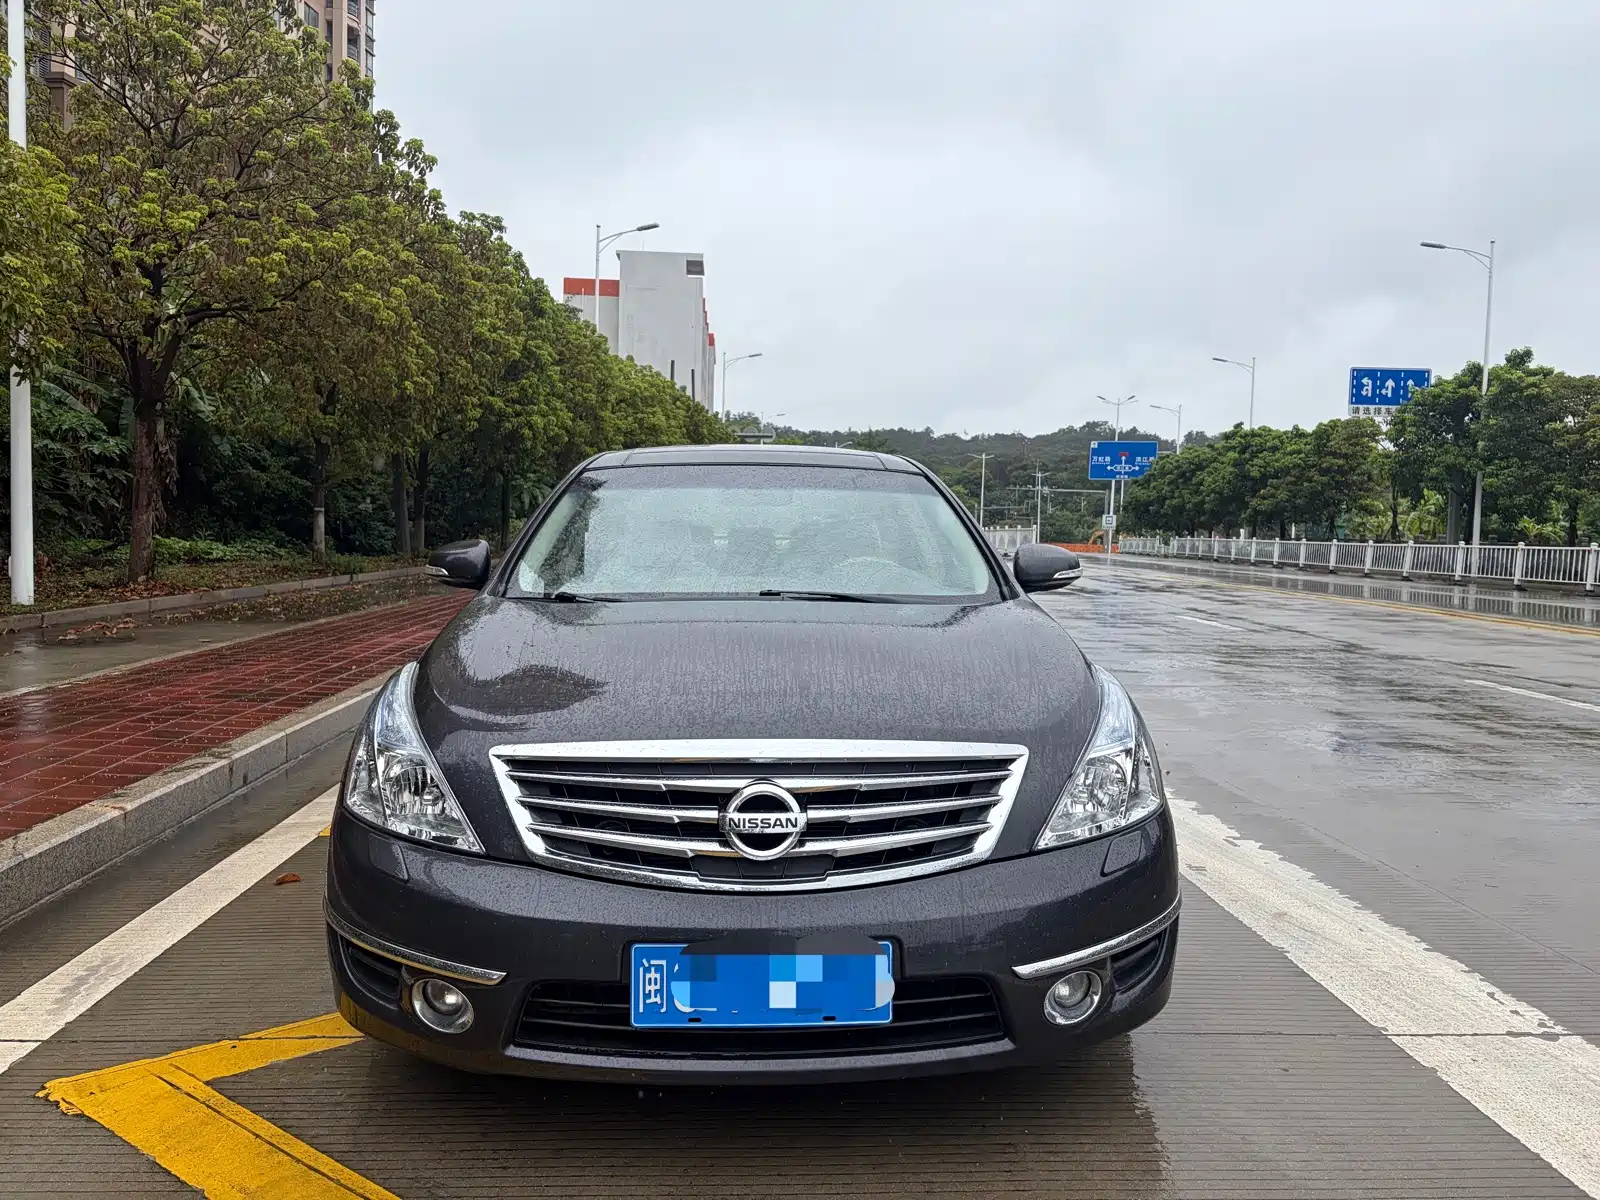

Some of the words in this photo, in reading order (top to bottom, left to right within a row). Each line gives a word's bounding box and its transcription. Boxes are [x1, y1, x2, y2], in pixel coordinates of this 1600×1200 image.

[1352, 406, 1397, 415] 请选择车
[728, 817, 798, 829] NISSAN
[639, 958, 667, 1013] 闽
